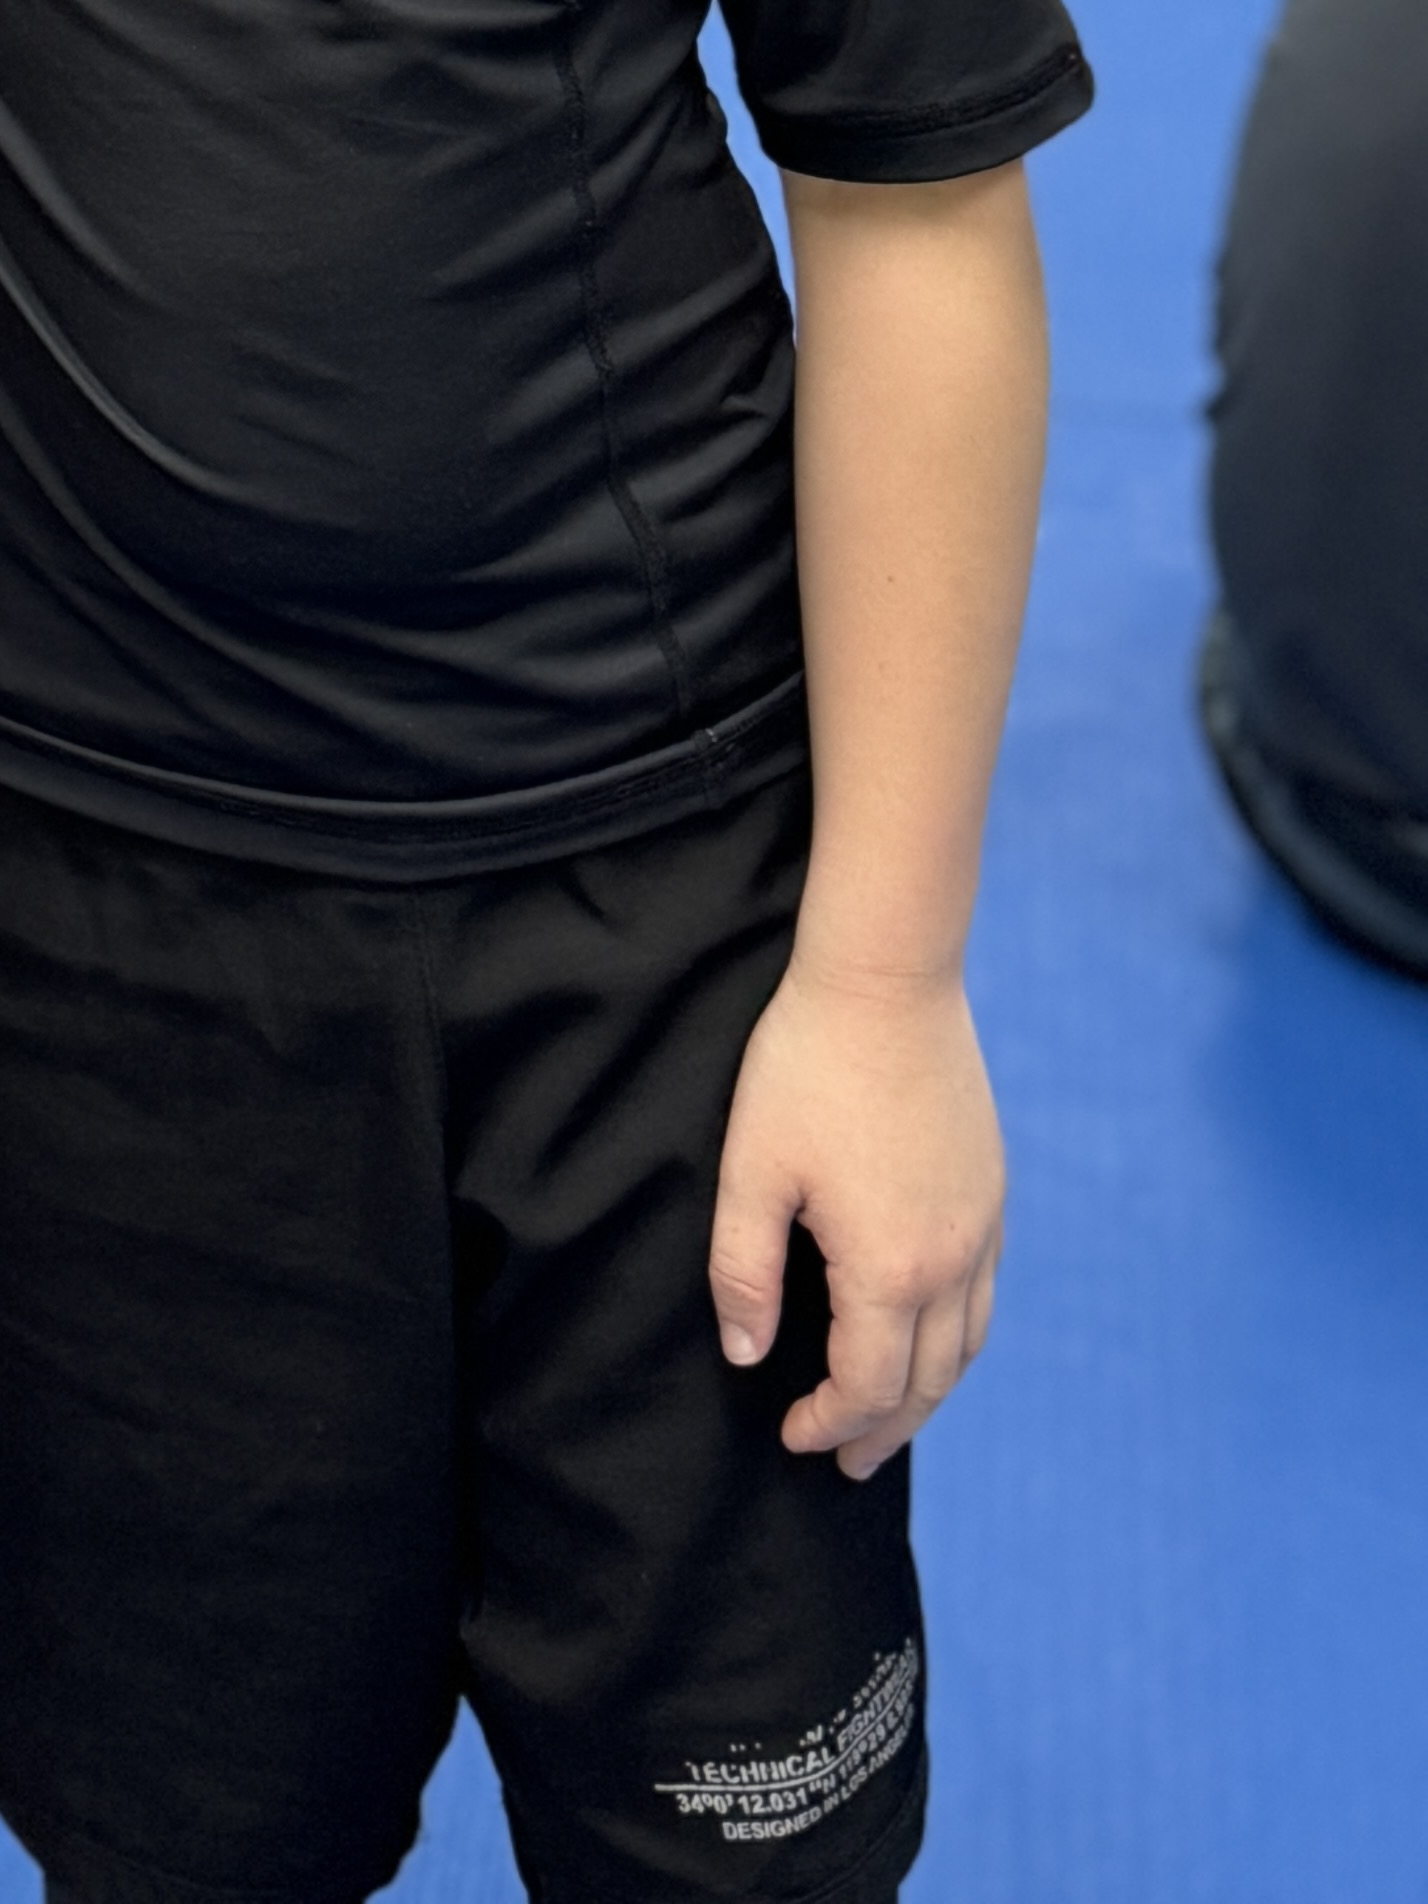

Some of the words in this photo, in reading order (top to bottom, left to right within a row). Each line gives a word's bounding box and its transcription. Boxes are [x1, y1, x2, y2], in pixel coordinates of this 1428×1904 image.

[685, 1746, 835, 1785] TECHNICAL
[721, 1805, 822, 1841] DESIGNED
[823, 1792, 839, 1813] IN
[840, 1765, 868, 1801] LOS
